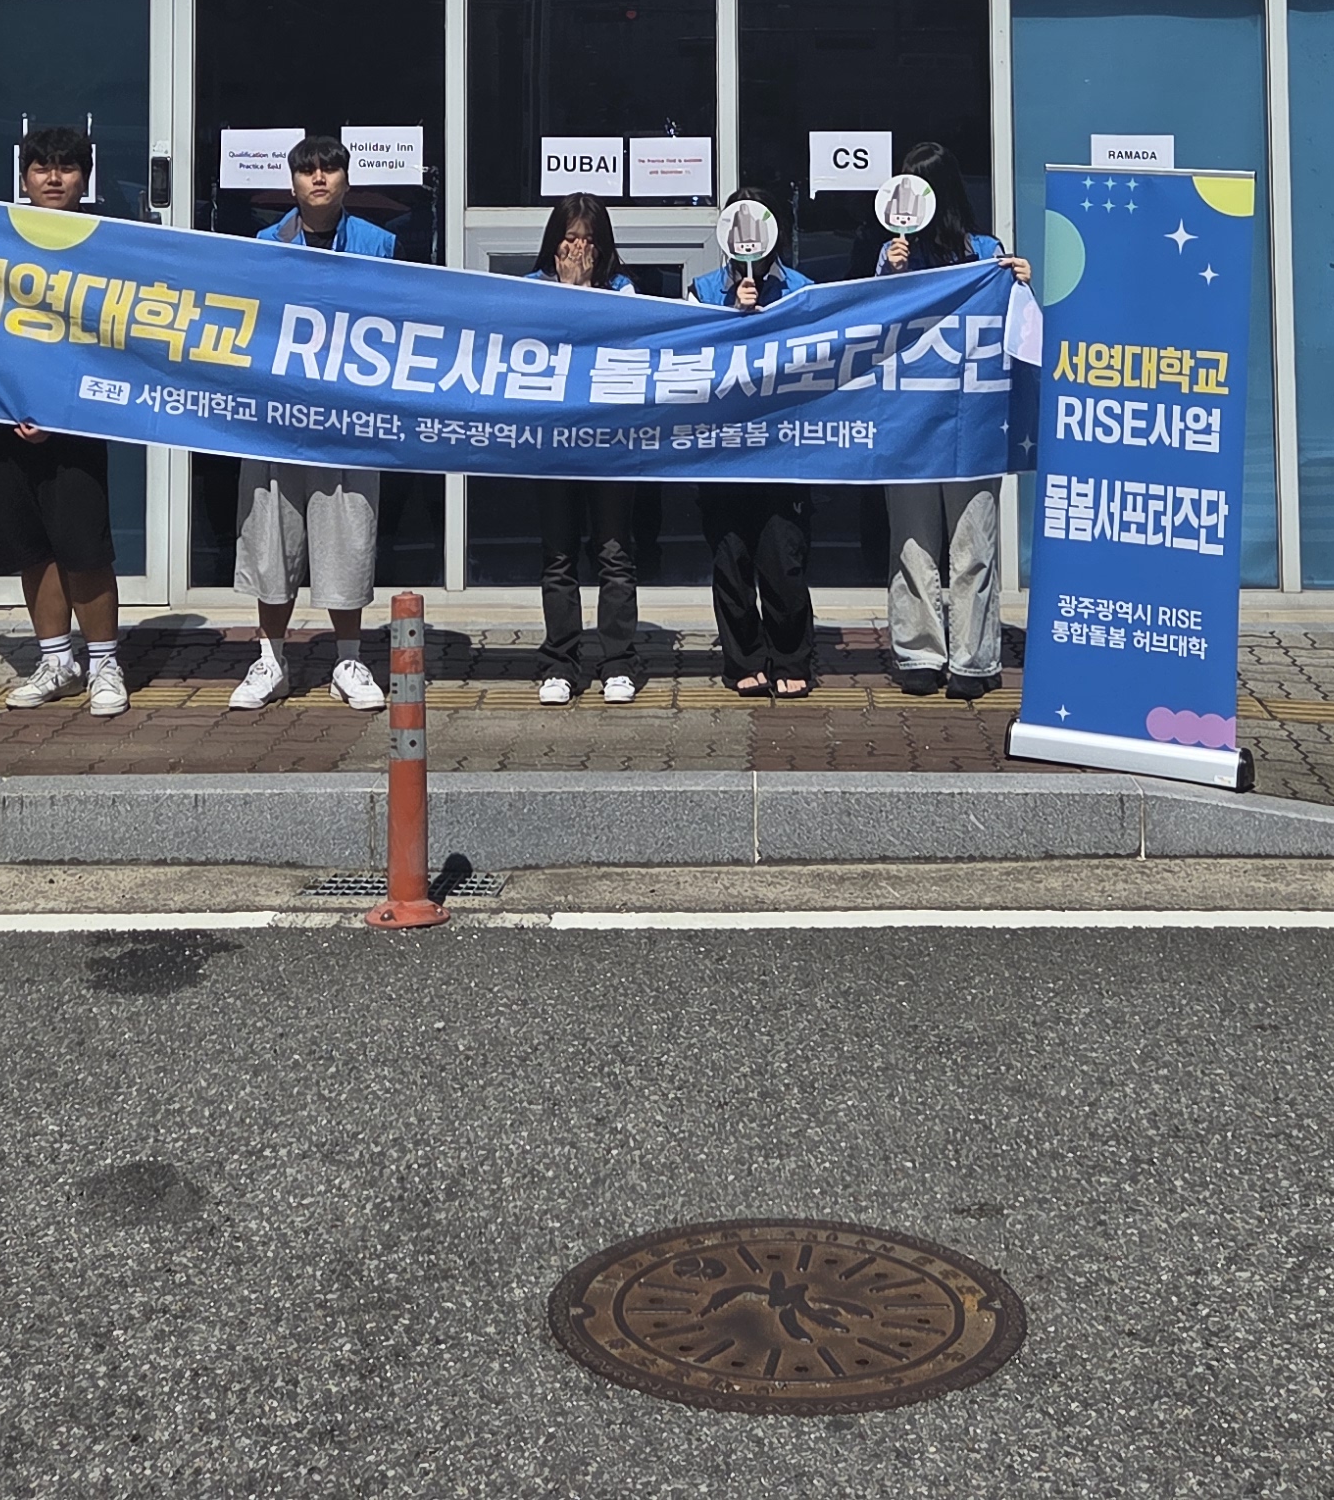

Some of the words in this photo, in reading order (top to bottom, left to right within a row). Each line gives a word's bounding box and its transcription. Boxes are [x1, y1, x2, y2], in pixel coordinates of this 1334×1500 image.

[350, 142, 392, 153] Holiday
[396, 142, 414, 152] Inn
[358, 159, 406, 170] Gwangju
[546, 155, 618, 173] DUBAI
[832, 147, 870, 170] CS
[1107, 149, 1158, 161] RAMADA
[271, 303, 573, 404] RISE사업
[588, 313, 1013, 404] 돌봄서포터즈단
[1052, 340, 1230, 395] 서영대학교
[85, 379, 124, 399] 주관
[136, 384, 258, 422] 서영대학교
[267, 402, 407, 442] RISE사업단,
[415, 417, 543, 450] 광주광역시
[552, 426, 661, 450] RISE사업
[670, 421, 769, 449] 통합돌봄
[779, 421, 878, 449] 허브대학
[1056, 395, 1221, 453] RISE사업
[1043, 473, 1229, 556] 돌봄서포터즈단
[1057, 594, 1152, 626] 광주광역시
[1158, 606, 1203, 631] RISE
[1051, 621, 1127, 650] 통합돌봄
[1132, 629, 1208, 661] 허브대학
